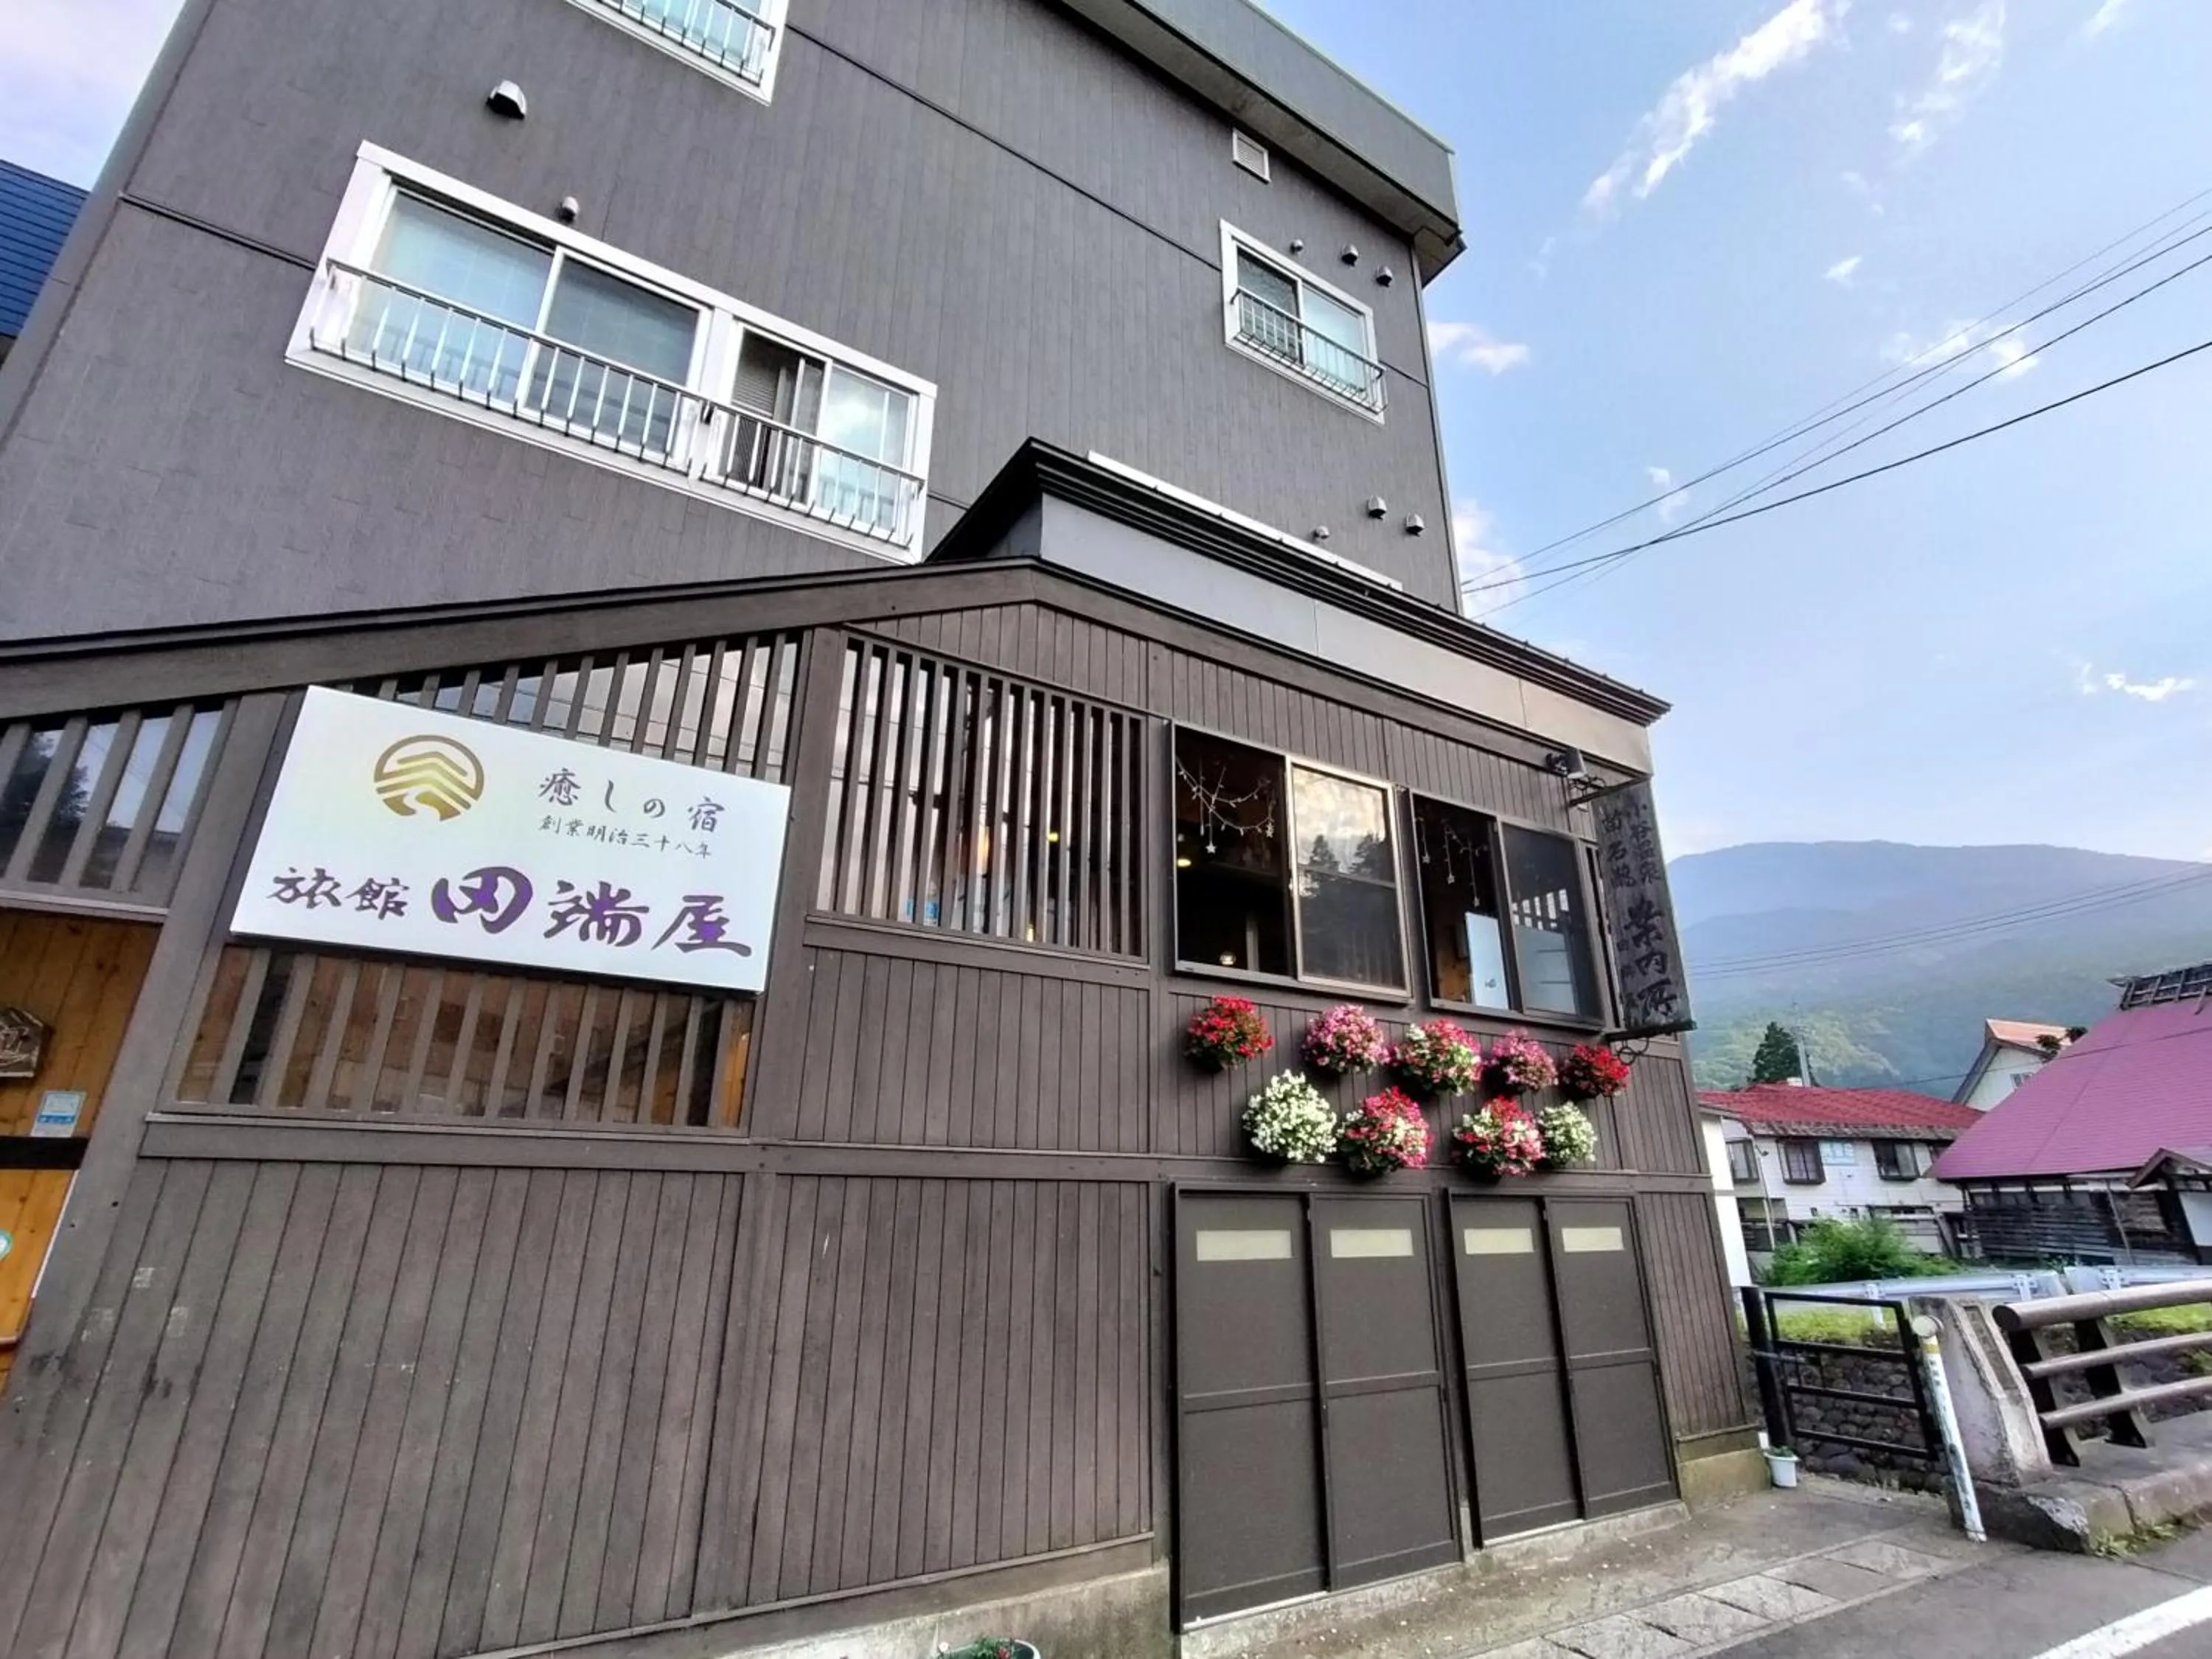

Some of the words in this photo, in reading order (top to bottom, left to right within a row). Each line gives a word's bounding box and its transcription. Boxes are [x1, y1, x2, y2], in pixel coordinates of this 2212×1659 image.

[538, 768, 726, 833] 癒しの宿
[539, 814, 712, 859] 創業明治三十八年
[268, 866, 411, 920] 旅館
[431, 866, 752, 958] 田端屋
